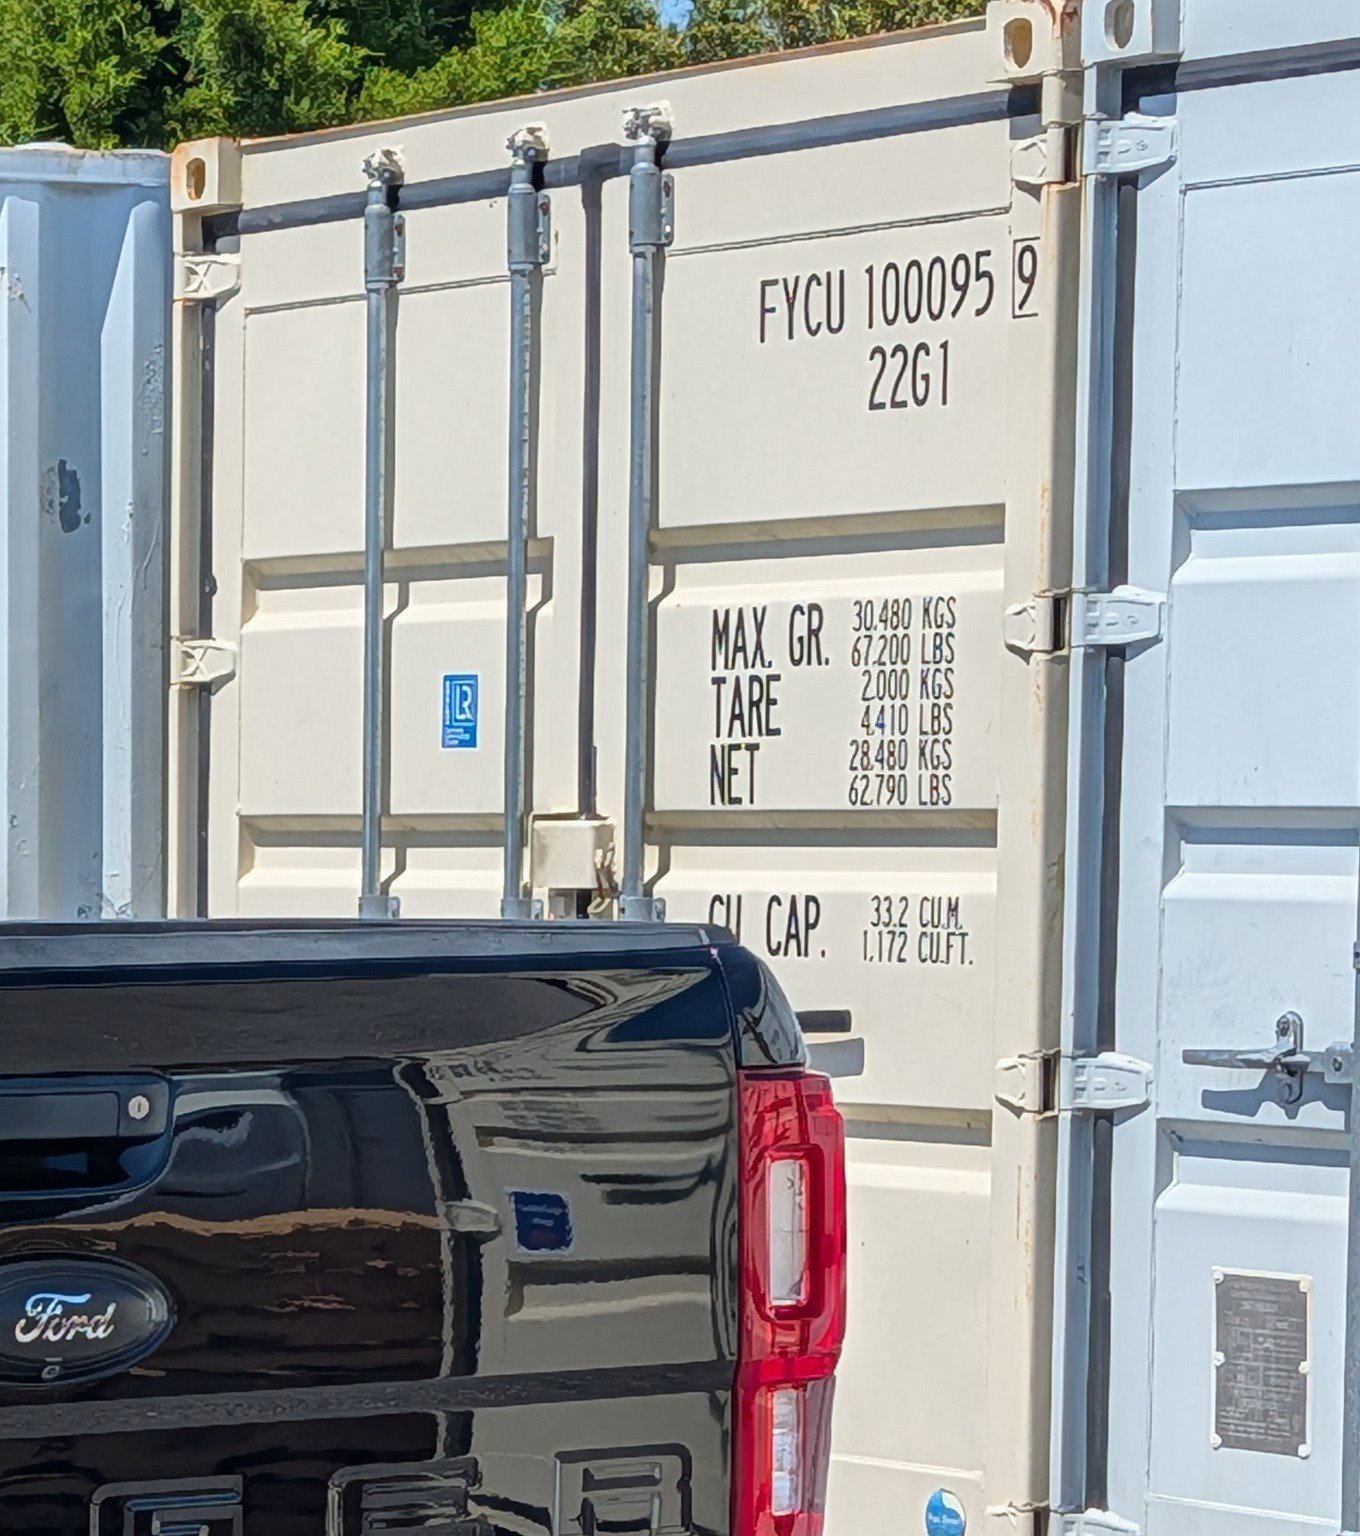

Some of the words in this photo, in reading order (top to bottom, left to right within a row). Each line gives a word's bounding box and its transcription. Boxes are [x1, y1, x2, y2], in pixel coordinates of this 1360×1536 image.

[760, 270, 845, 343] FYCU
[864, 250, 994, 329] 100095
[1018, 244, 1038, 311] 9
[868, 340, 949, 411] 22G1
[922, 596, 957, 630] KGS
[711, 605, 773, 671] MAX.
[789, 603, 830, 667] GR.
[921, 632, 956, 665] LBS
[920, 667, 955, 700] KGS
[711, 674, 781, 738] TARE
[919, 702, 954, 736] LBS
[710, 743, 760, 806] NET
[918, 738, 953, 771] KGS
[918, 773, 952, 806] LBS
[766, 894, 826, 958] CAP.
[870, 895, 909, 928] 33.2
[14, 1293, 117, 1343] Ford
